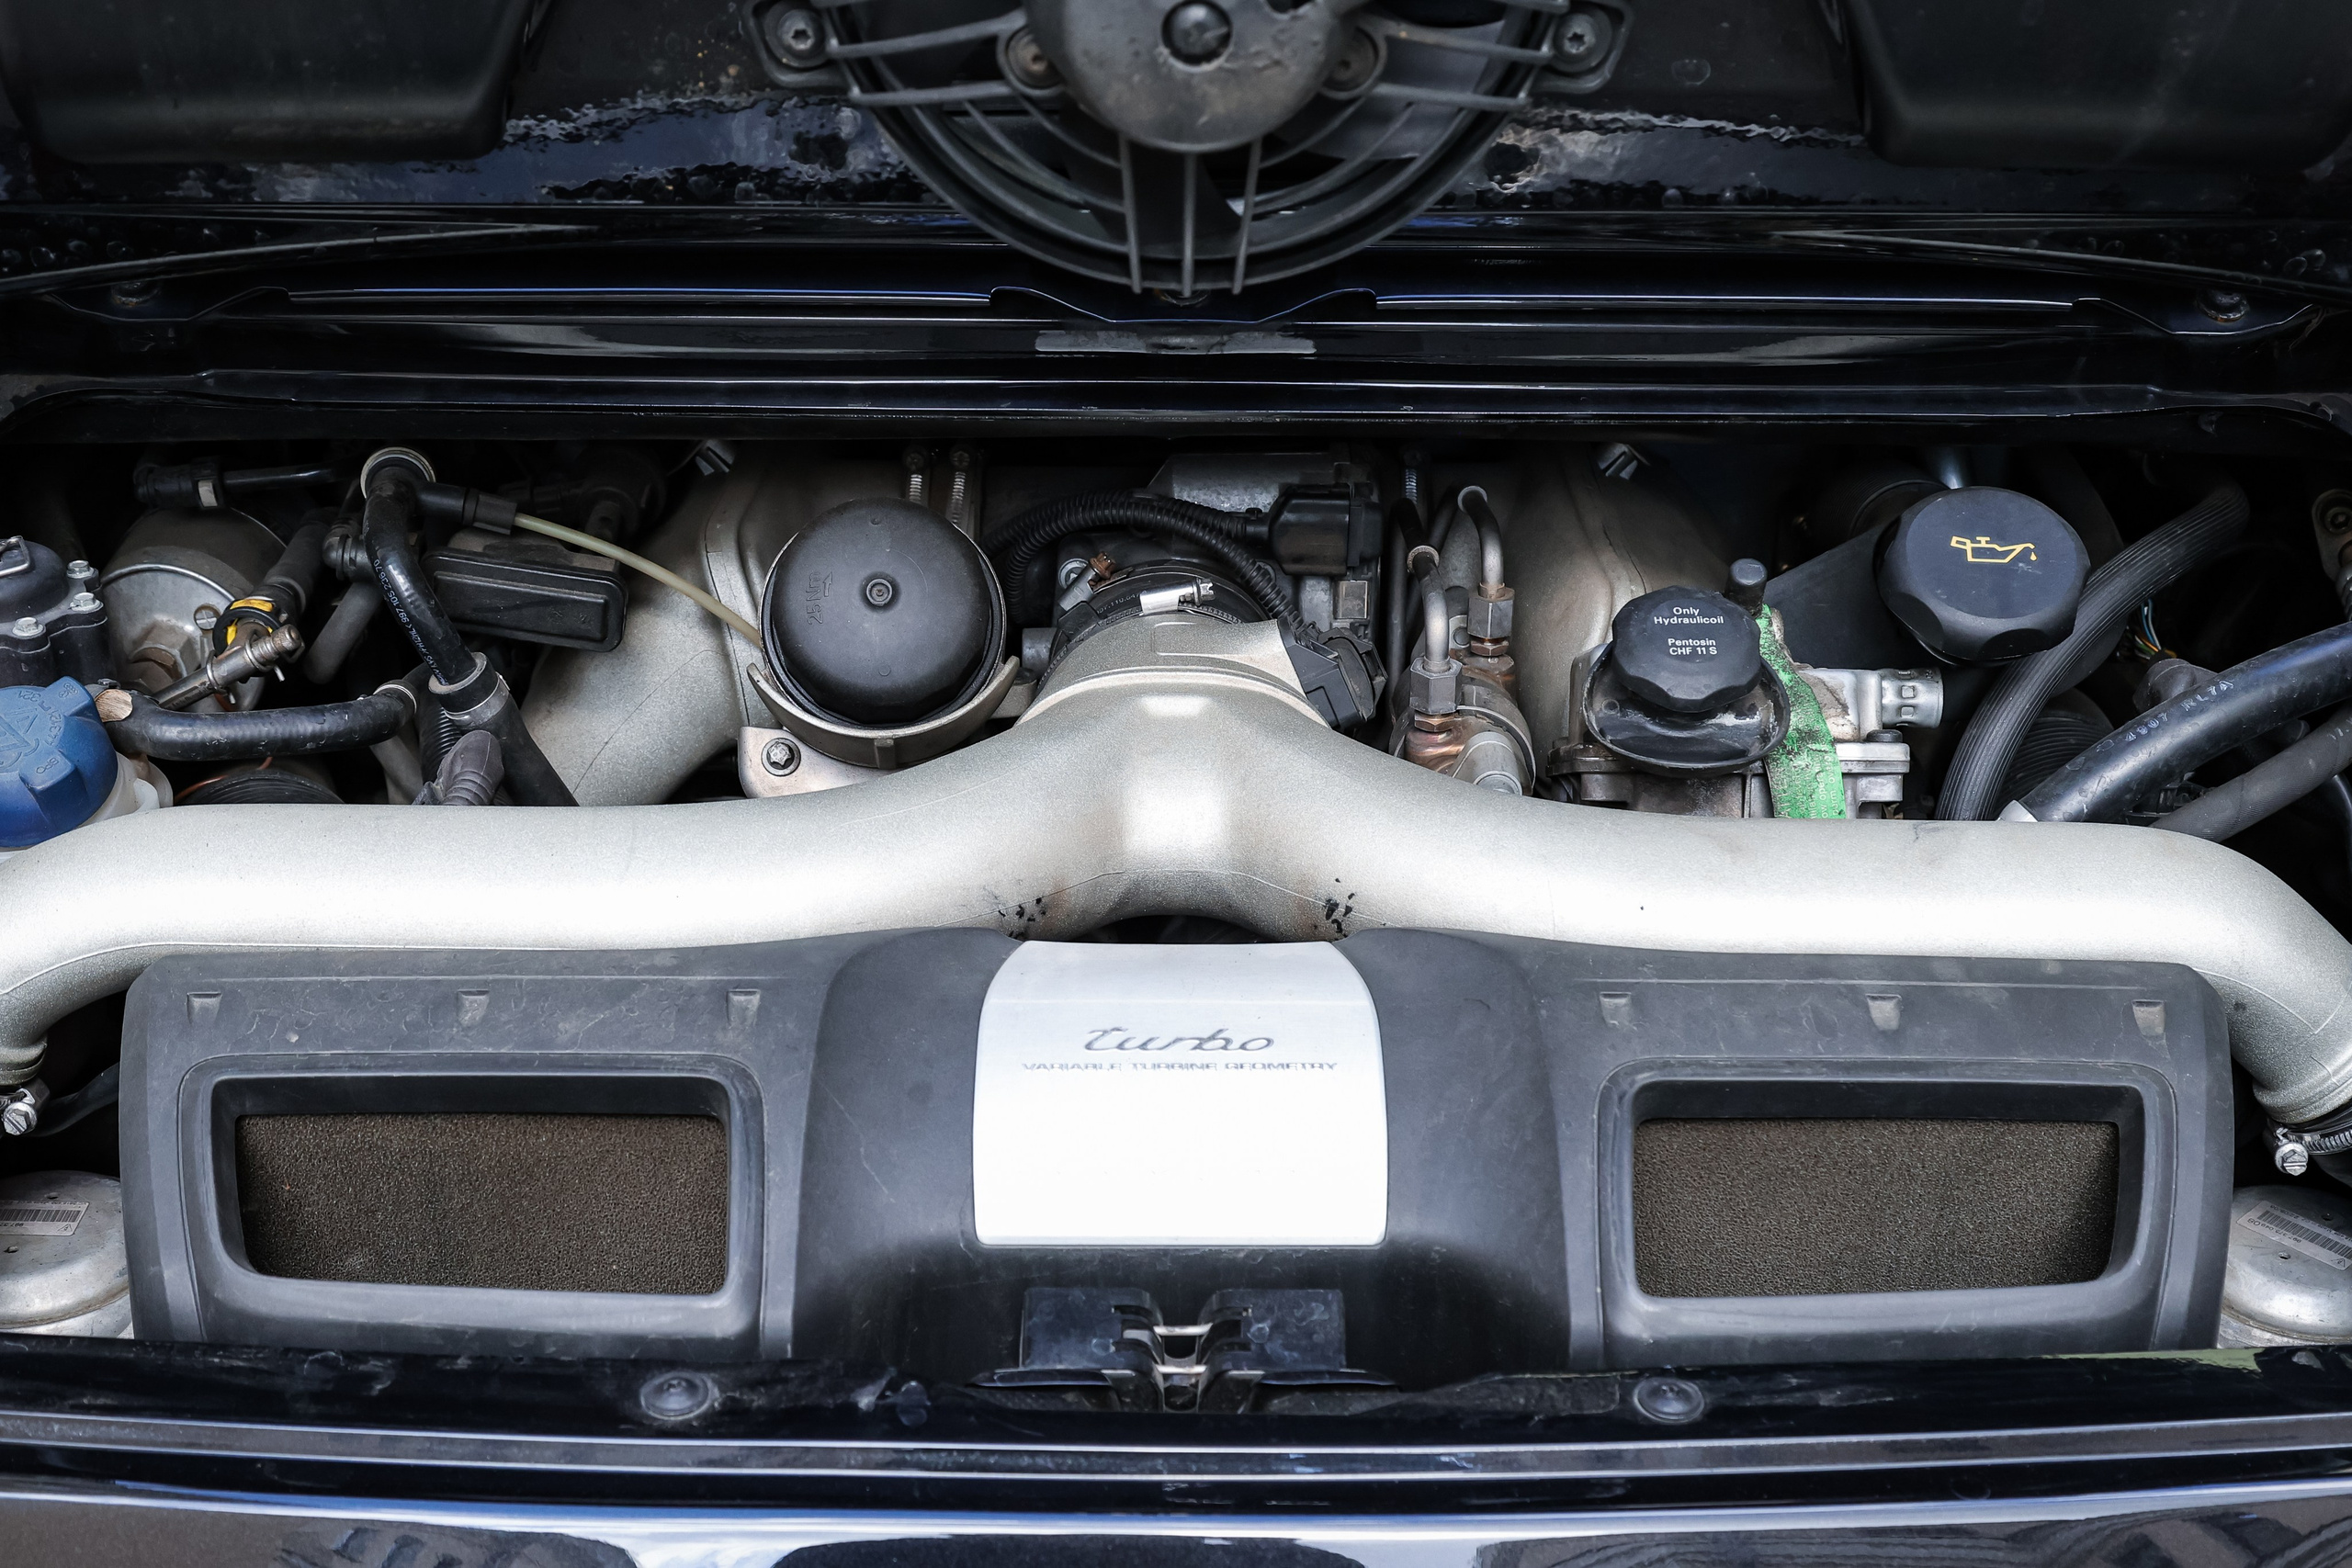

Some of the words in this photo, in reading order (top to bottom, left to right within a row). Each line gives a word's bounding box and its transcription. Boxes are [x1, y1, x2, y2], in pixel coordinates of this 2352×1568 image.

[806, 571, 821, 602] Nm
[807, 604, 823, 626] 25
[1673, 606, 1700, 616] Only
[1654, 616, 1724, 626] Hydraulicoil
[1669, 647, 1692, 655] CHF
[1696, 647, 1706, 655] 11
[1710, 647, 1717, 655] S
[1085, 1026, 1274, 1051] turbo
[1022, 1062, 1123, 1072] VARIABLE
[1130, 1062, 1217, 1071] TURBINE
[1225, 1062, 1338, 1072] GEOMETRY
